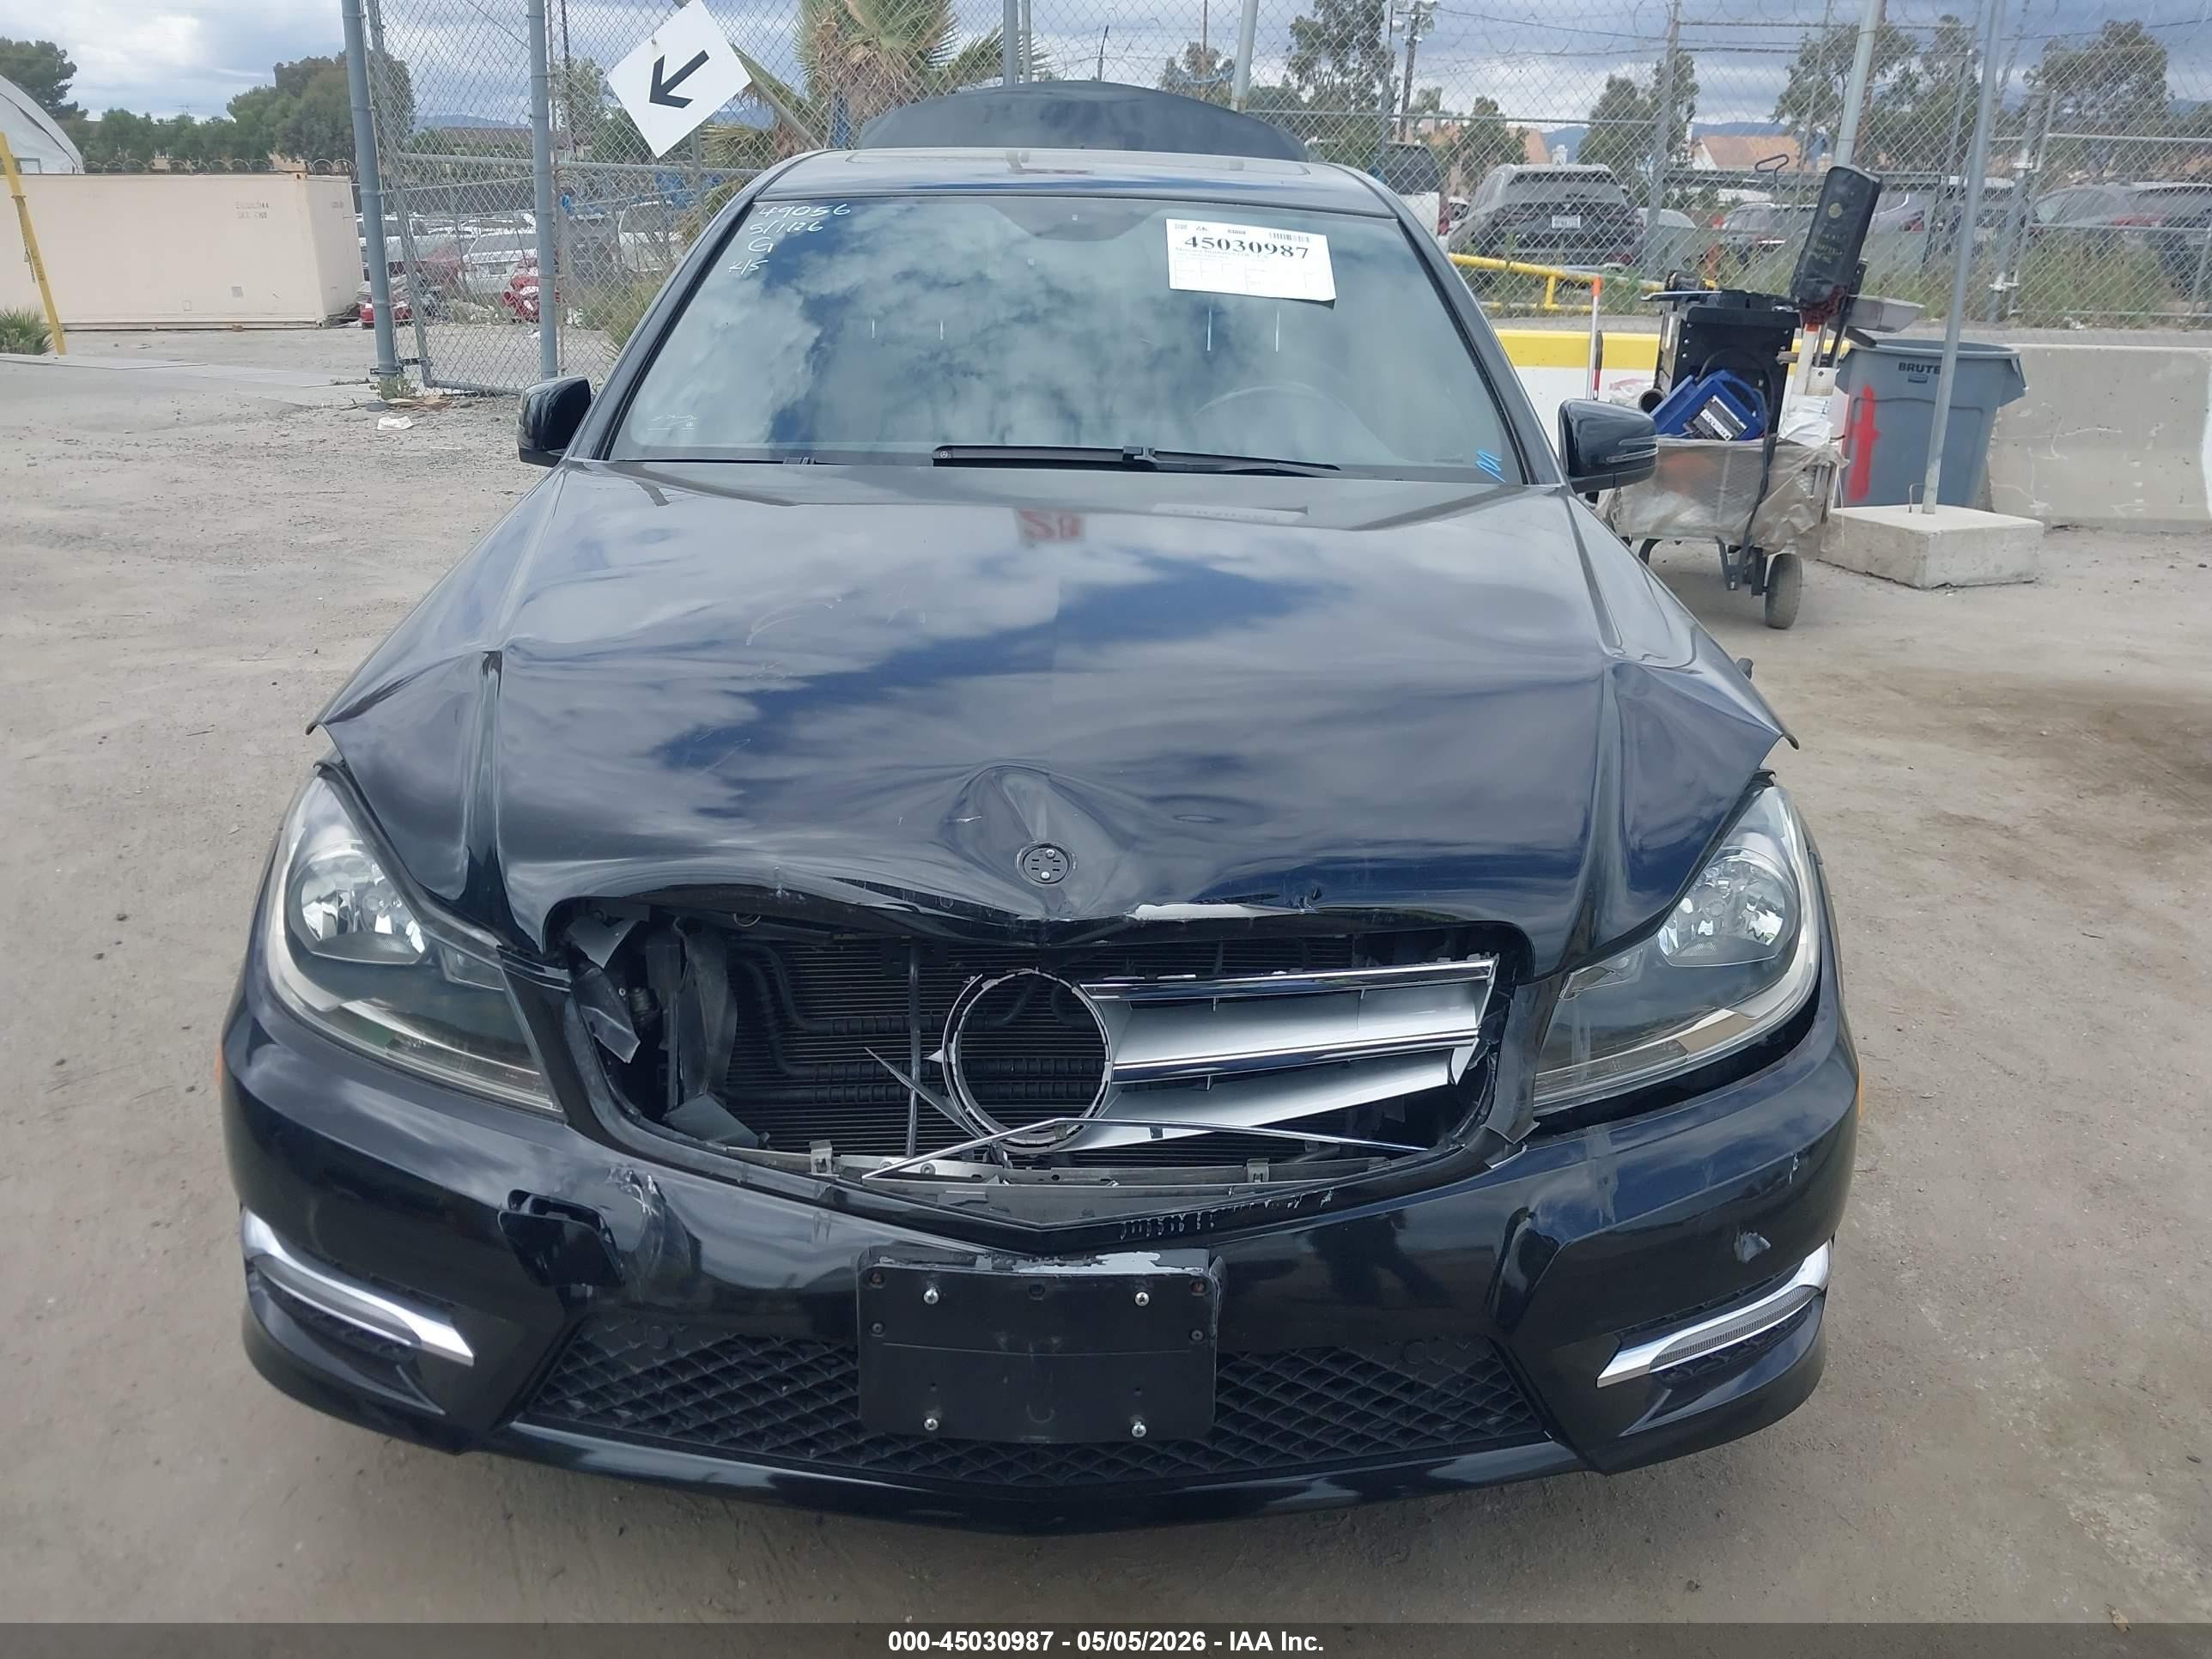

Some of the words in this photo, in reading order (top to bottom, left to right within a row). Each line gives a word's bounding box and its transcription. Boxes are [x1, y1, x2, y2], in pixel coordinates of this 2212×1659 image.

[758, 204, 851, 219] 49056
[1184, 235, 1309, 259] 45030987
[1898, 362, 1942, 375] BRUTE
